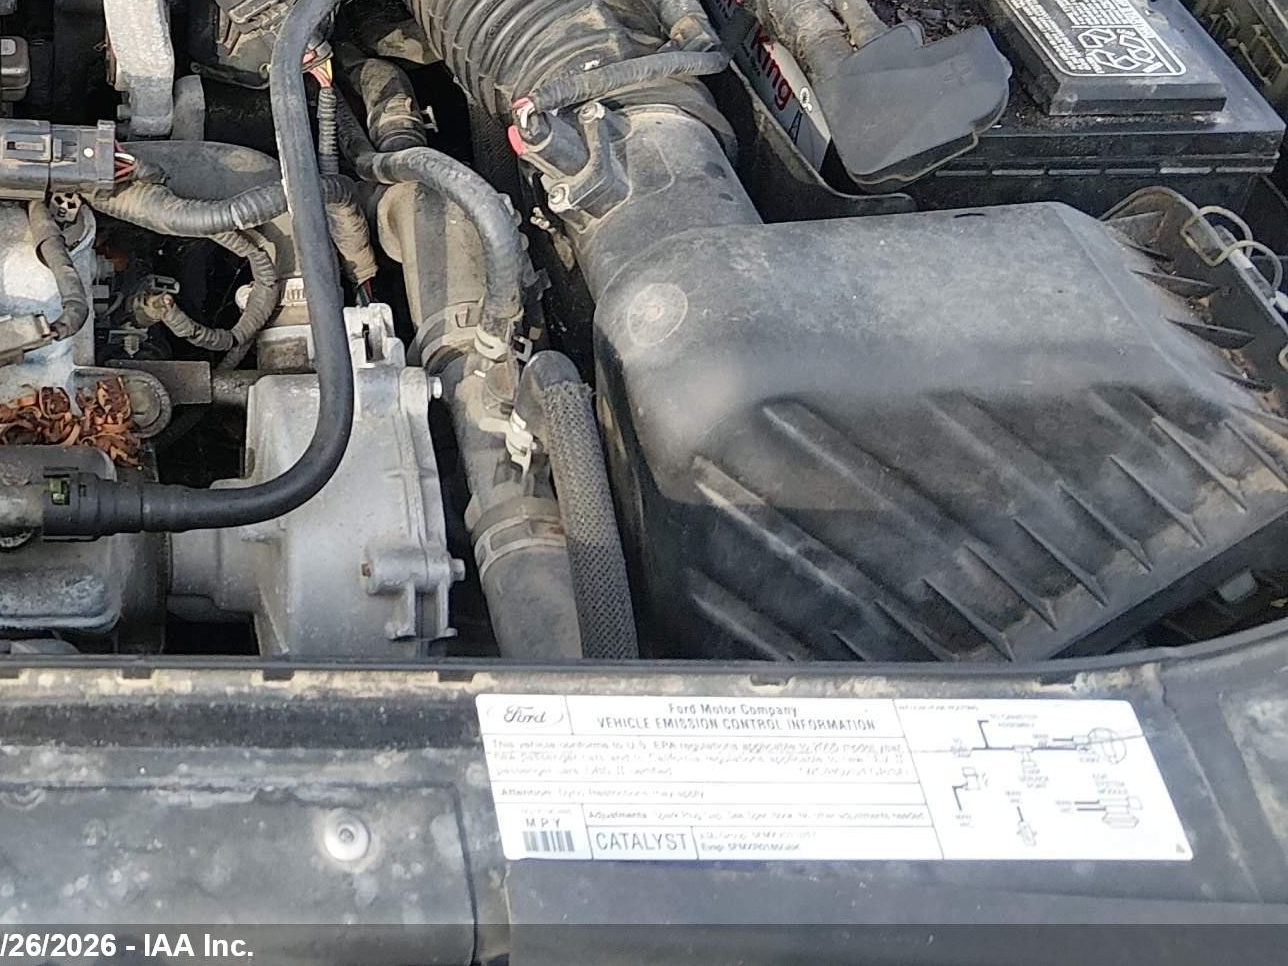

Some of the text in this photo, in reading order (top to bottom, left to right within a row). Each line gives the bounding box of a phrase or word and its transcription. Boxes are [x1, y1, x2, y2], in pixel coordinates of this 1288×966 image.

[503, 705, 547, 724] Ford
[668, 703, 798, 718] Ford Motor Company
[596, 717, 876, 732] VEHICLE EMISSION CONTROL INFORMATION
[526, 818, 537, 828] M
[595, 832, 688, 851] CATALYST
